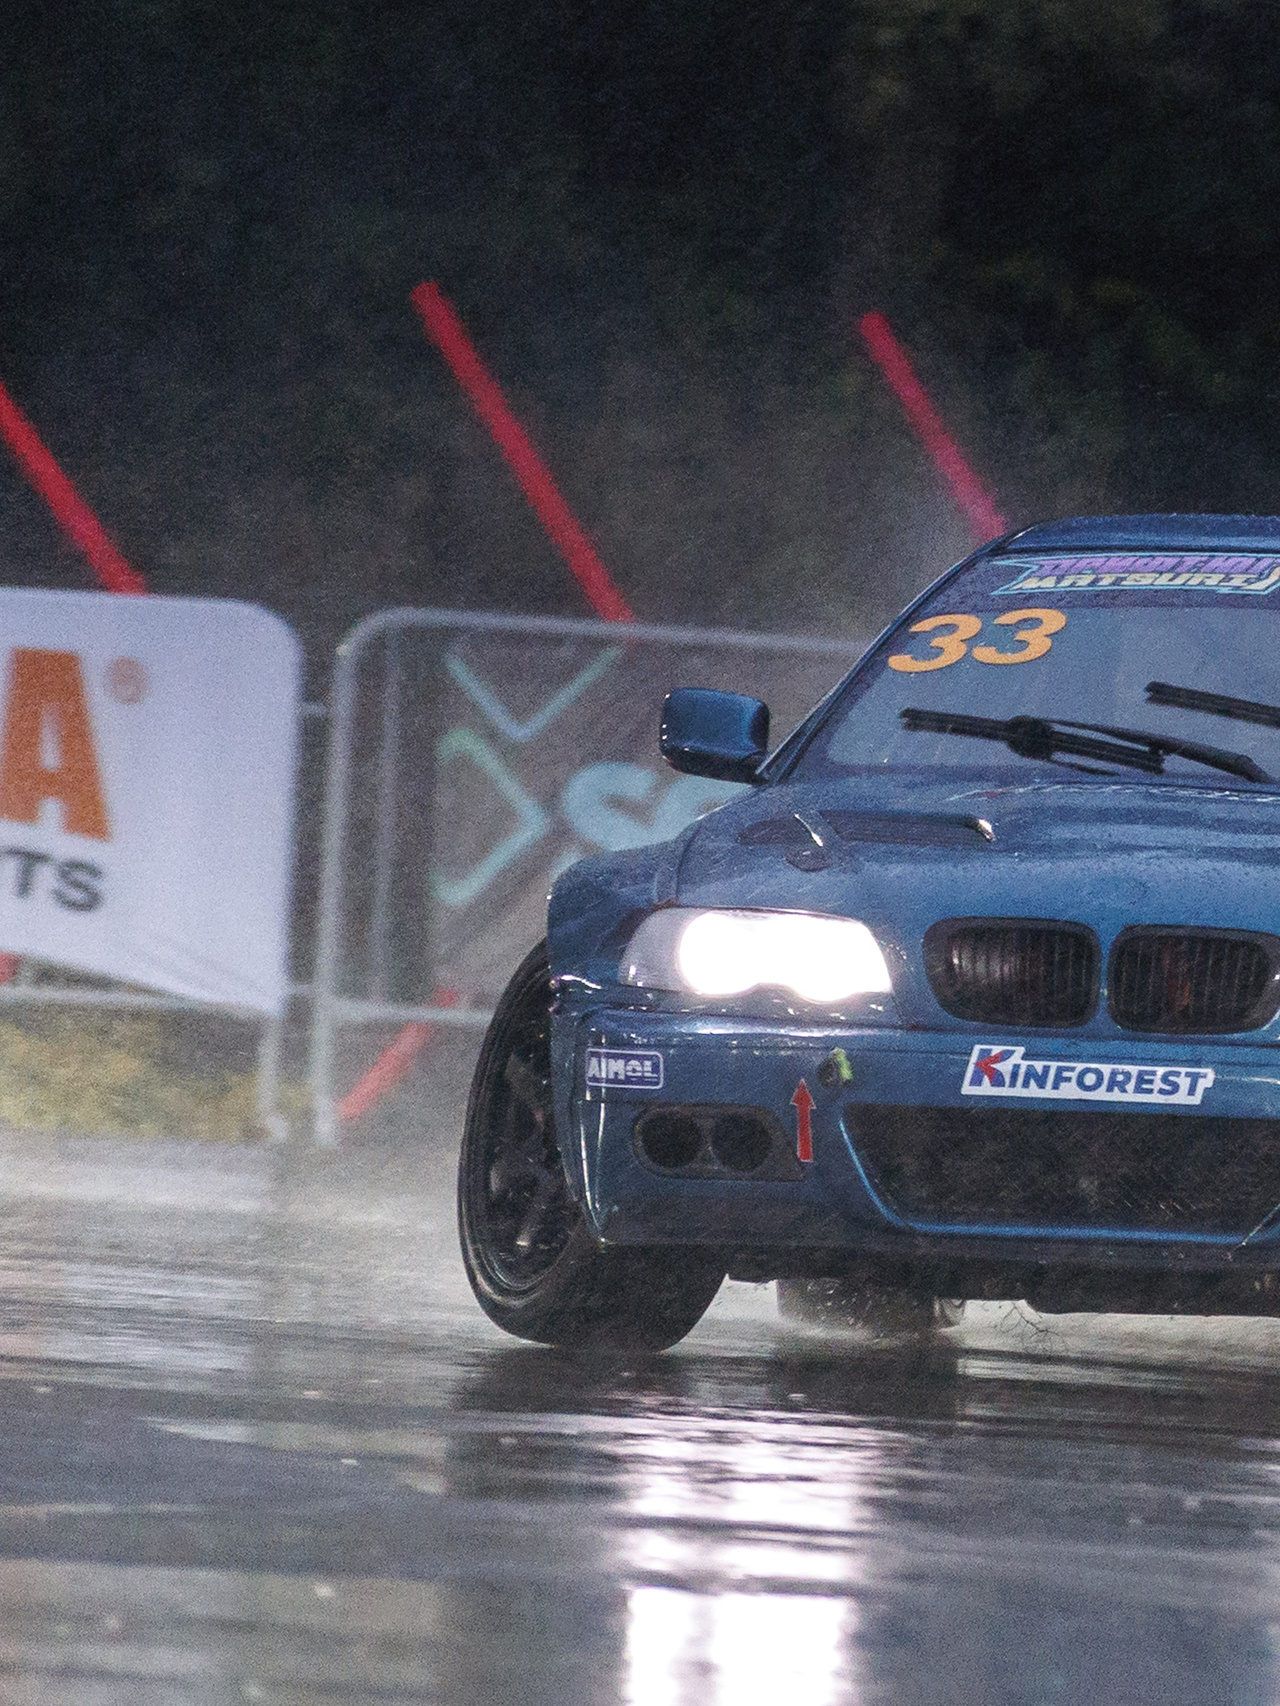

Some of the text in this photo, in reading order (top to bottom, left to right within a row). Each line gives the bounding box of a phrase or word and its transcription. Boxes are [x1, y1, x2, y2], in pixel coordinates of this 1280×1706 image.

[1010, 572, 1261, 591] MATSURI
[887, 607, 1067, 673] 33
[587, 1056, 659, 1081] AIMOL
[968, 1048, 1208, 1097] KINFOREST
